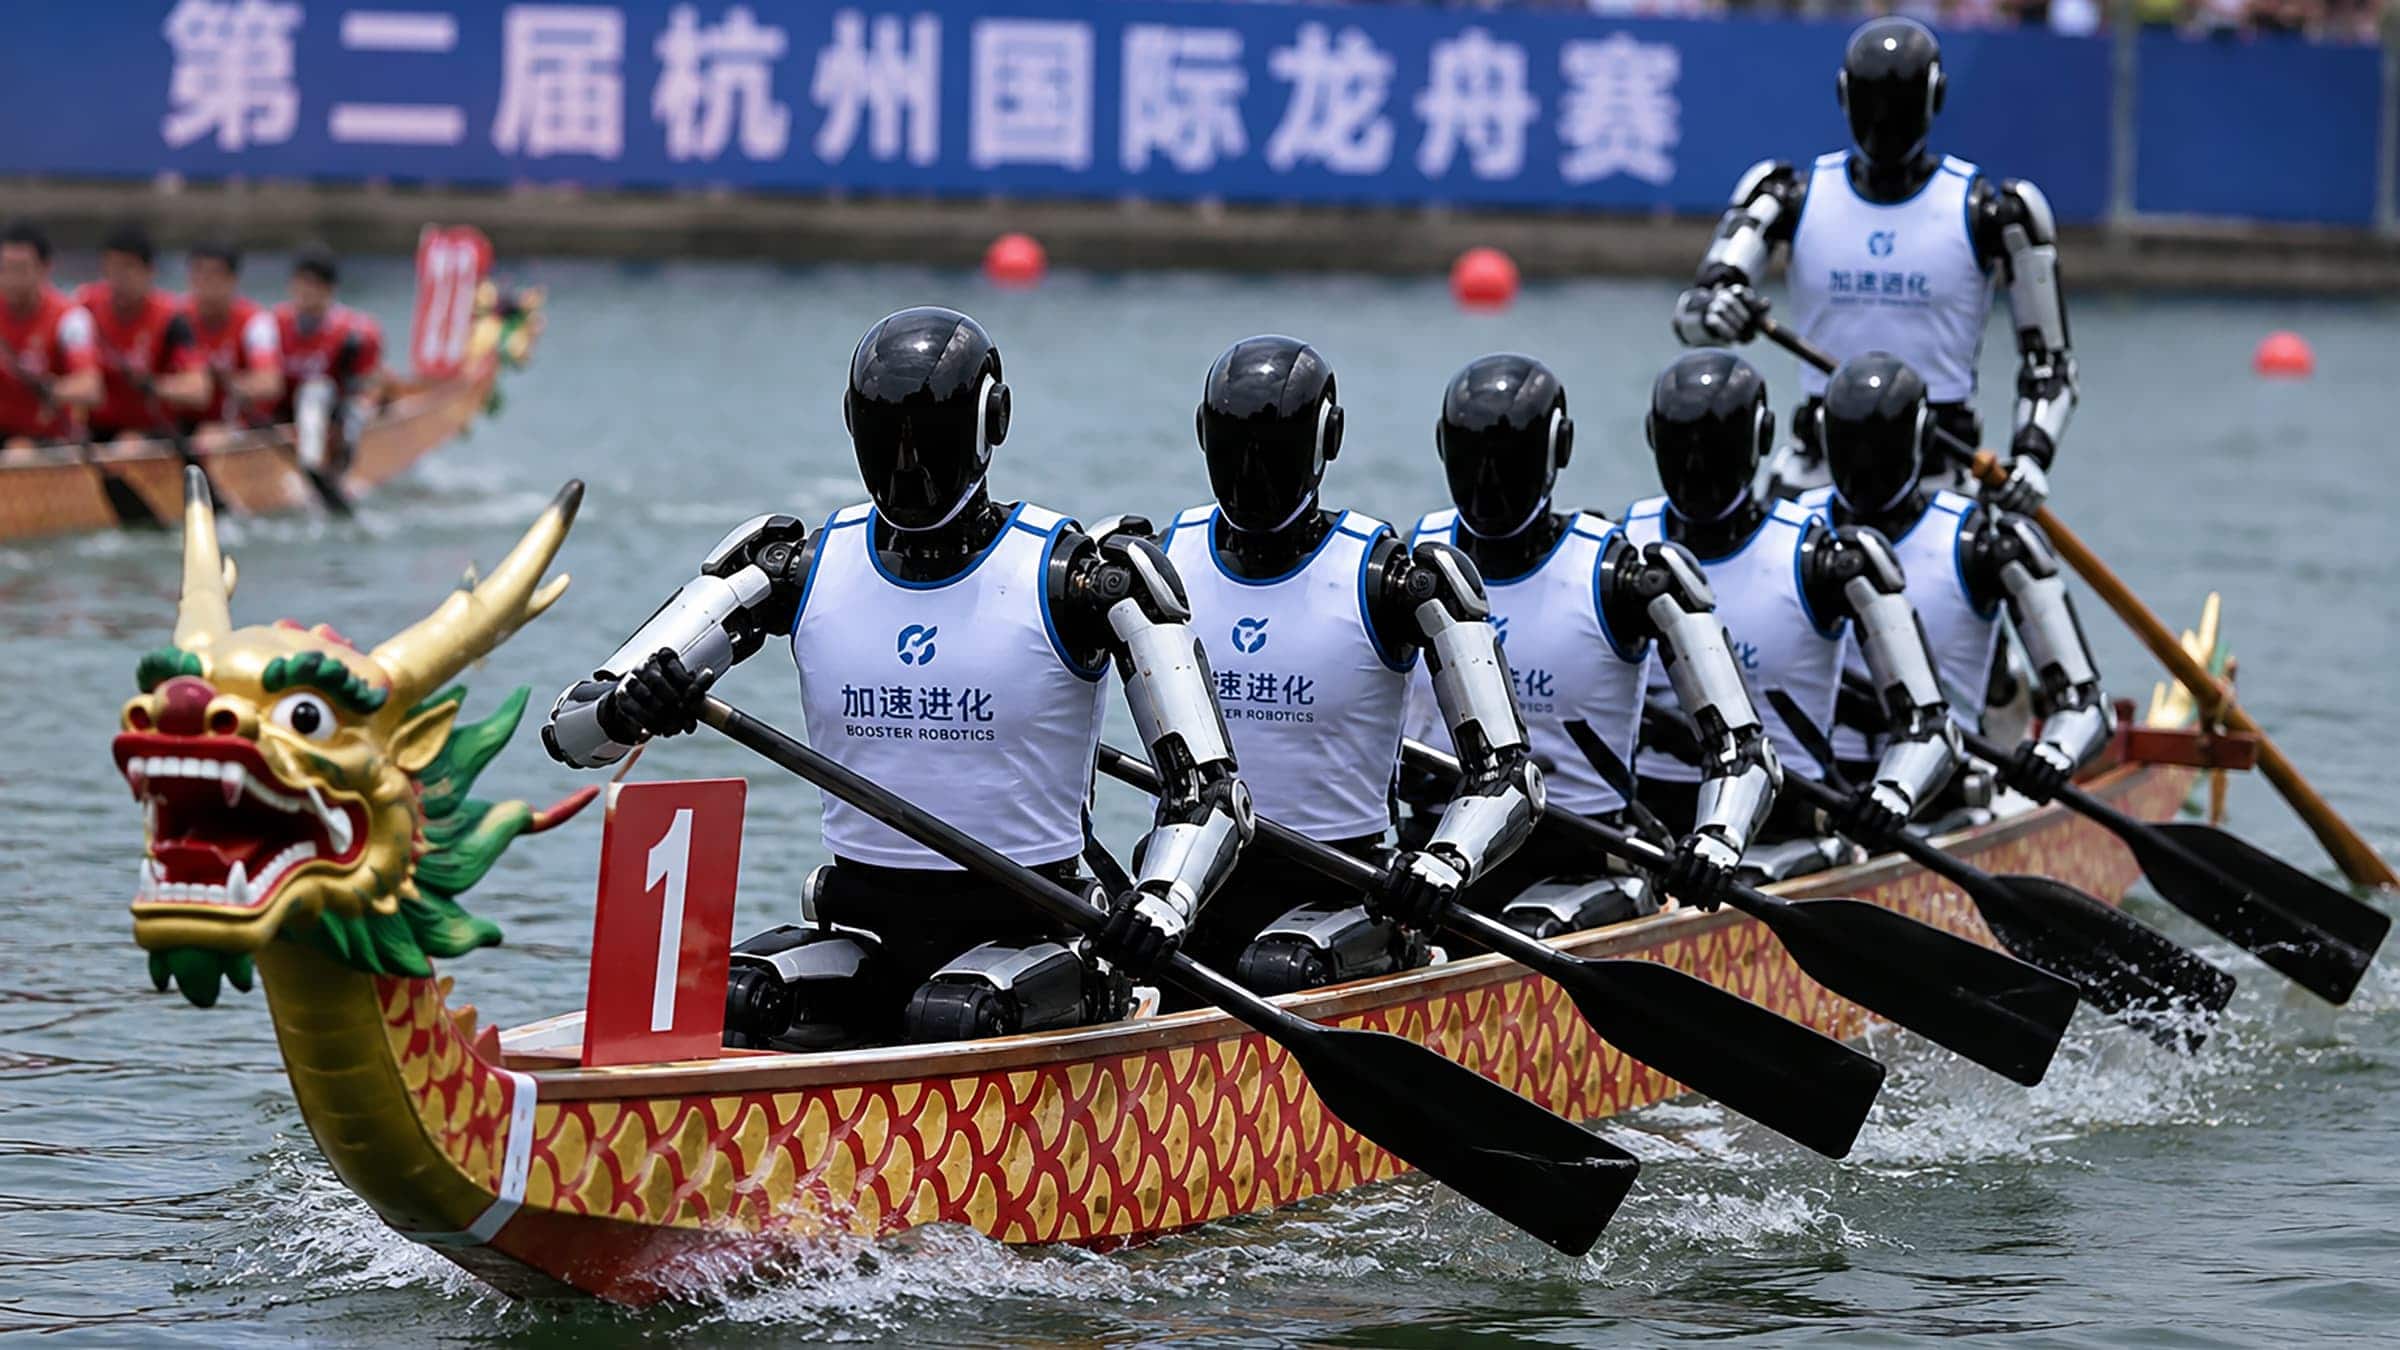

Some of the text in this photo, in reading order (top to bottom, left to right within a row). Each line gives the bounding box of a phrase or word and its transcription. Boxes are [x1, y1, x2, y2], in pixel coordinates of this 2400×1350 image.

[163, 1, 1678, 178] 第二届杭州国际龙舟赛
[841, 684, 994, 722] 加速进化
[1212, 670, 1315, 705] 速进化
[846, 725, 995, 742] BOOSTER ROBOTICS
[645, 808, 694, 1032] 1
